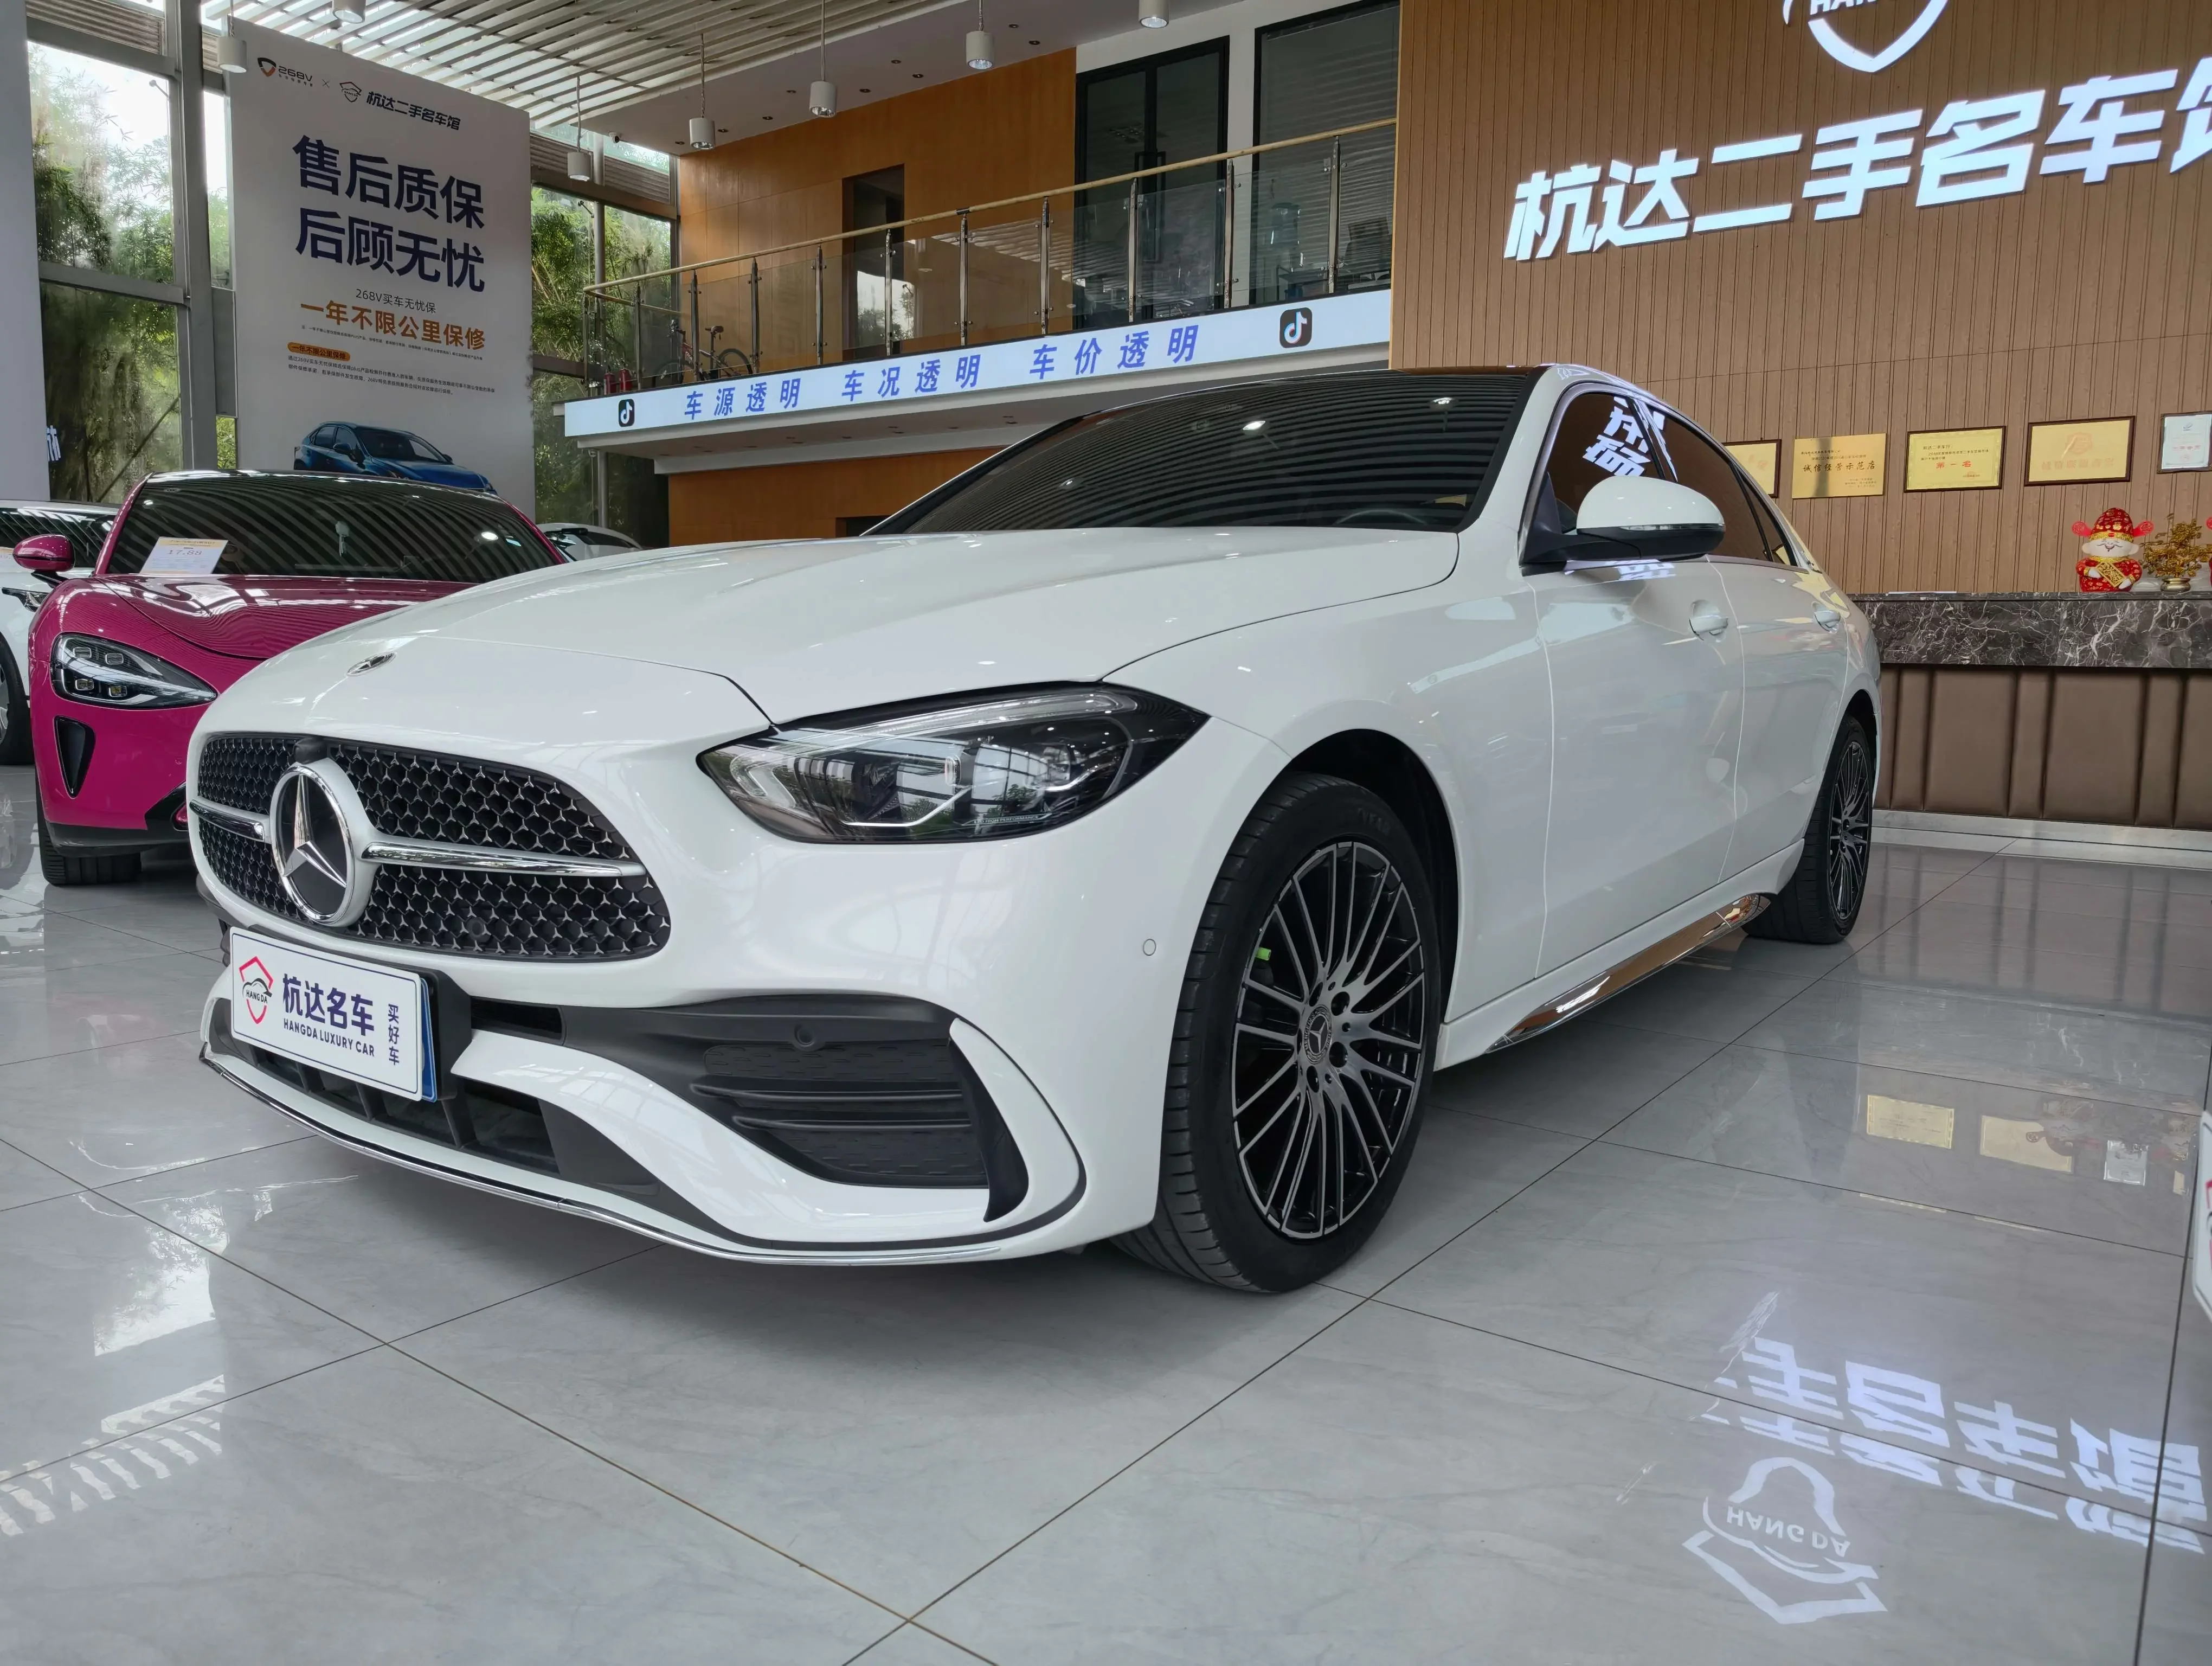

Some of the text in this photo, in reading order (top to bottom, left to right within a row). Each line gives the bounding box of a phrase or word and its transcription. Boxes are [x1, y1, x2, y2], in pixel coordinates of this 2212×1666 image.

[278, 65, 313, 82] 268V
[366, 91, 461, 131] 杭达二手名车馆
[292, 136, 485, 229] 售后质保
[295, 208, 485, 293] 后顾无忧
[356, 289, 436, 314] 268V买车无忧保
[300, 300, 485, 351] 一年不限公里保修
[684, 325, 1199, 420] 车源透明 车况透明 车价透明
[1803, 459, 1876, 473] 诚信经营示范店
[1935, 460, 1972, 470] 第一名
[246, 989, 268, 1004] HANG DA
[282, 973, 374, 1036] 杭达名车
[284, 1018, 375, 1057] HANGDA LUXURY CAR
[388, 1003, 400, 1066] 买好车
